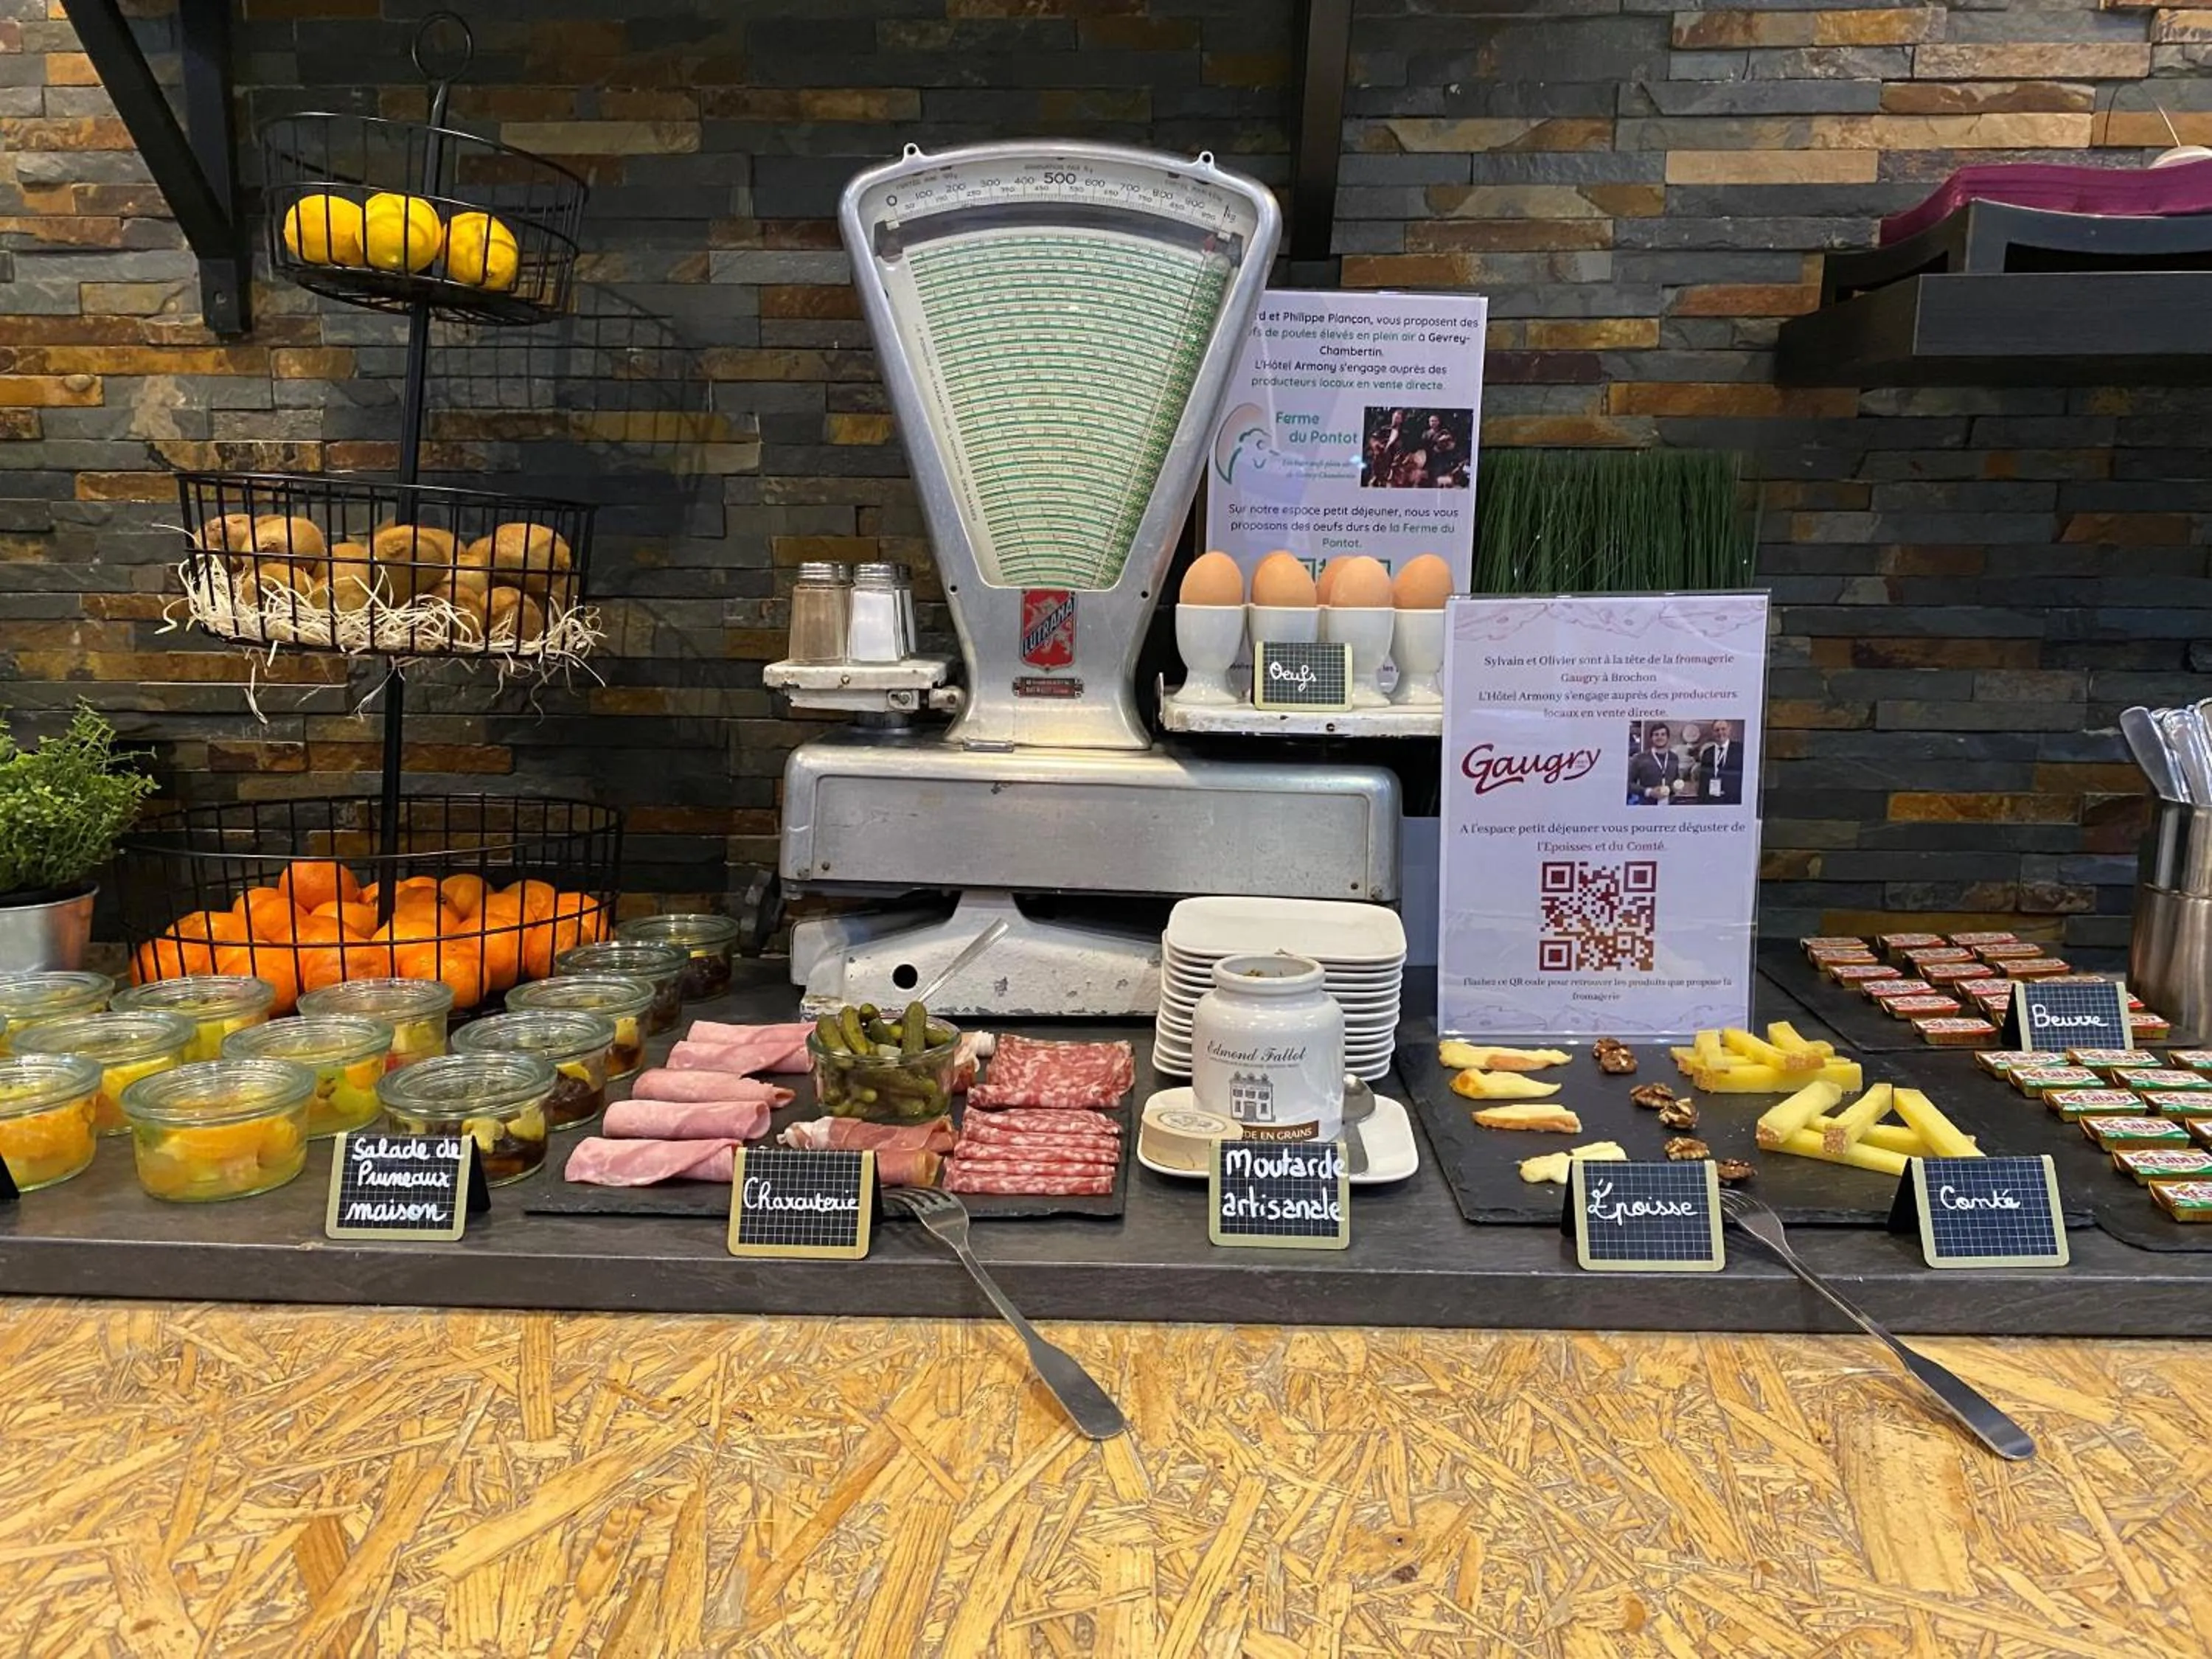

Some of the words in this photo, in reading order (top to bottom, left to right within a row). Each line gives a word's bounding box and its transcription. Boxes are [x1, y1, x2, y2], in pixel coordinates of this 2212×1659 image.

[915, 189, 933, 199] 100
[945, 183, 967, 193] 200
[980, 178, 1001, 187] 300
[1015, 176, 1034, 185] 400
[1043, 172, 1077, 185] 500
[1085, 178, 1105, 187] 600
[1120, 183, 1141, 192] 700
[1152, 189, 1173, 200] 800
[1269, 311, 1280, 321] et
[1283, 311, 1325, 323] Philippe
[1376, 316, 1401, 325] vous
[1404, 317, 1457, 327] proposent
[1459, 318, 1479, 328] des
[1265, 327, 1279, 337] de
[1281, 328, 1318, 340] poules
[1356, 331, 1371, 340] en
[1372, 331, 1399, 342] plein
[1402, 333, 1416, 341] air
[1294, 361, 1337, 374] Armony
[1339, 362, 1387, 375] s'engage
[1428, 364, 1447, 375] des
[1251, 377, 1317, 388] producteurs
[1319, 378, 1354, 389] locaux
[1357, 380, 1370, 389] en
[1372, 380, 1404, 389] vente
[1275, 411, 1320, 425] Ferme
[1289, 430, 1307, 443] du
[1310, 431, 1358, 445] Pontot
[1228, 503, 1247, 515] Sur
[1249, 504, 1280, 515] notre
[1281, 506, 1321, 516] espace
[1323, 506, 1349, 517] petit
[1405, 508, 1430, 518] nous
[1433, 509, 1459, 518] vous
[1230, 521, 1289, 532] proposons
[1291, 521, 1311, 532] des
[1346, 522, 1370, 532] durs
[1372, 523, 1387, 533] de
[1389, 523, 1400, 533] la
[1402, 523, 1439, 533] Ferme
[1440, 524, 1455, 533] du
[1484, 655, 1525, 668] Sylvain
[1526, 656, 1537, 666] et
[1539, 655, 1576, 666] Olivier
[1579, 656, 1601, 665] sont
[1613, 655, 1622, 664] la
[1624, 655, 1646, 664] tête
[1648, 654, 1662, 664] de
[1663, 654, 1673, 664] la
[1676, 653, 1734, 666] fromagerie
[1269, 661, 1317, 692] Oeufs
[1561, 672, 1599, 684] Gaugry
[1611, 672, 1657, 682] Brochon
[1518, 691, 1562, 703] Armony
[1565, 690, 1610, 703] s'engage
[1650, 689, 1669, 700] des
[1672, 689, 1738, 701] producteurs
[1544, 708, 1579, 718] locaux
[1581, 709, 1593, 717] en
[1596, 709, 1626, 718] vente
[1461, 743, 1601, 795] Gaugry
[1470, 822, 1517, 835] l'espace
[1518, 823, 1545, 835] petit
[1548, 822, 1599, 835] déjeuner
[1601, 824, 1629, 833] vous
[1631, 824, 1676, 835] pourrez
[1678, 821, 1728, 835] déguster
[1731, 821, 1745, 832] de
[1595, 842, 1607, 852] et
[1608, 841, 1624, 851] du
[1509, 978, 1524, 987] QR
[1629, 978, 1666, 988] produits
[2031, 1004, 2109, 1027] Beurre
[1207, 1040, 1259, 1061] Edmond
[1260, 1046, 1307, 1062] Fallot
[1260, 1130, 1274, 1140] EN
[1276, 1127, 1312, 1141] GRAINS
[352, 1137, 431, 1161] Salade
[436, 1138, 465, 1160] de
[1226, 1147, 1349, 1180] Moutarde
[357, 1160, 451, 1188] Pruneaux
[1222, 1185, 1346, 1222] artisanale
[1940, 1184, 2021, 1210] Comté
[345, 1199, 447, 1222] maison
